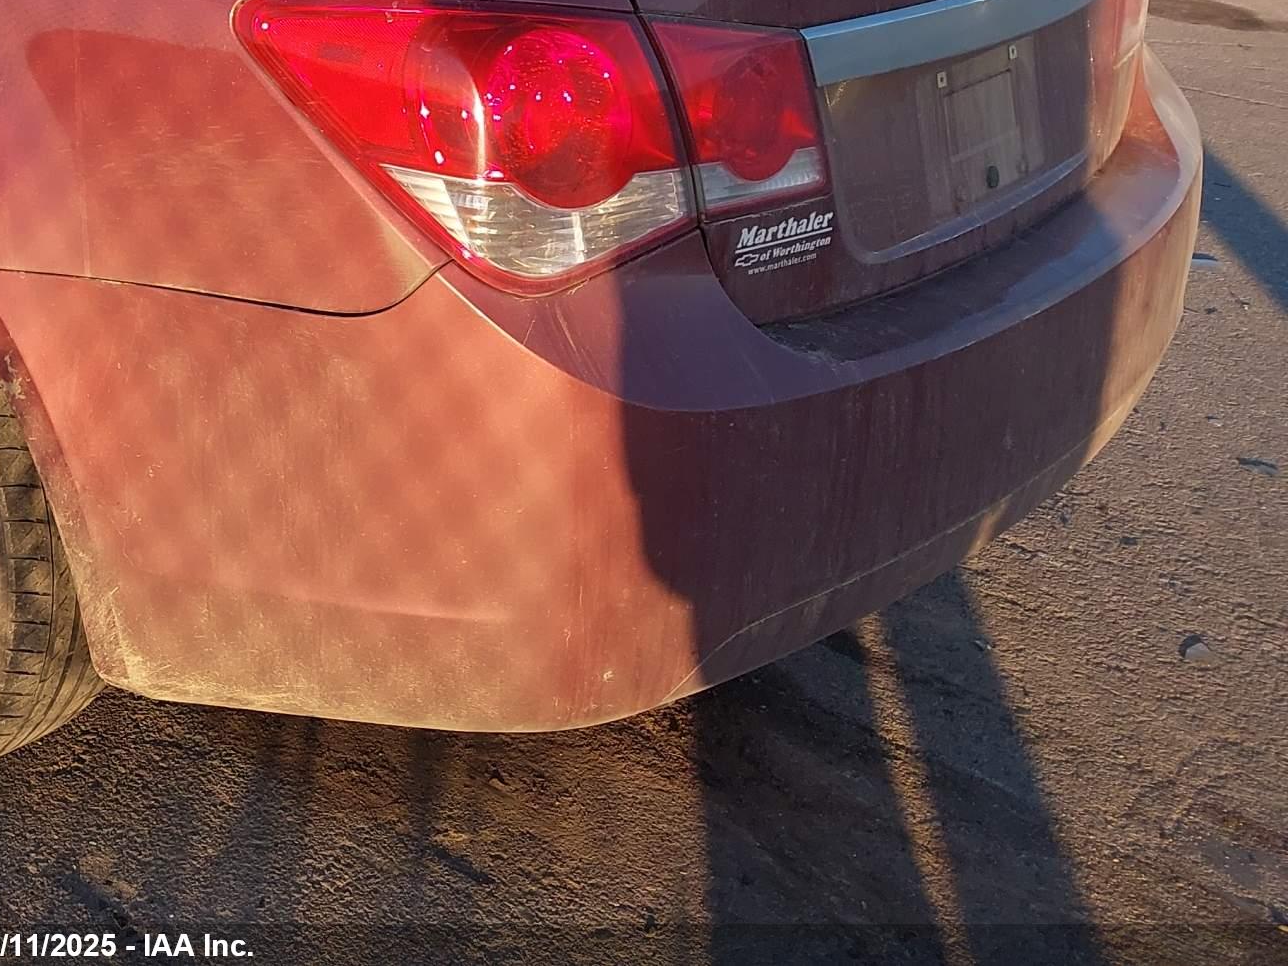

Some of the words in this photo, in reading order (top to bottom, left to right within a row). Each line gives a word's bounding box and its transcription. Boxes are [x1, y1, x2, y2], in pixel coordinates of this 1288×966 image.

[737, 211, 834, 248] Marthaler
[759, 249, 771, 262] of
[773, 236, 832, 259] Worthington
[748, 253, 817, 275] www.marthaler.com
